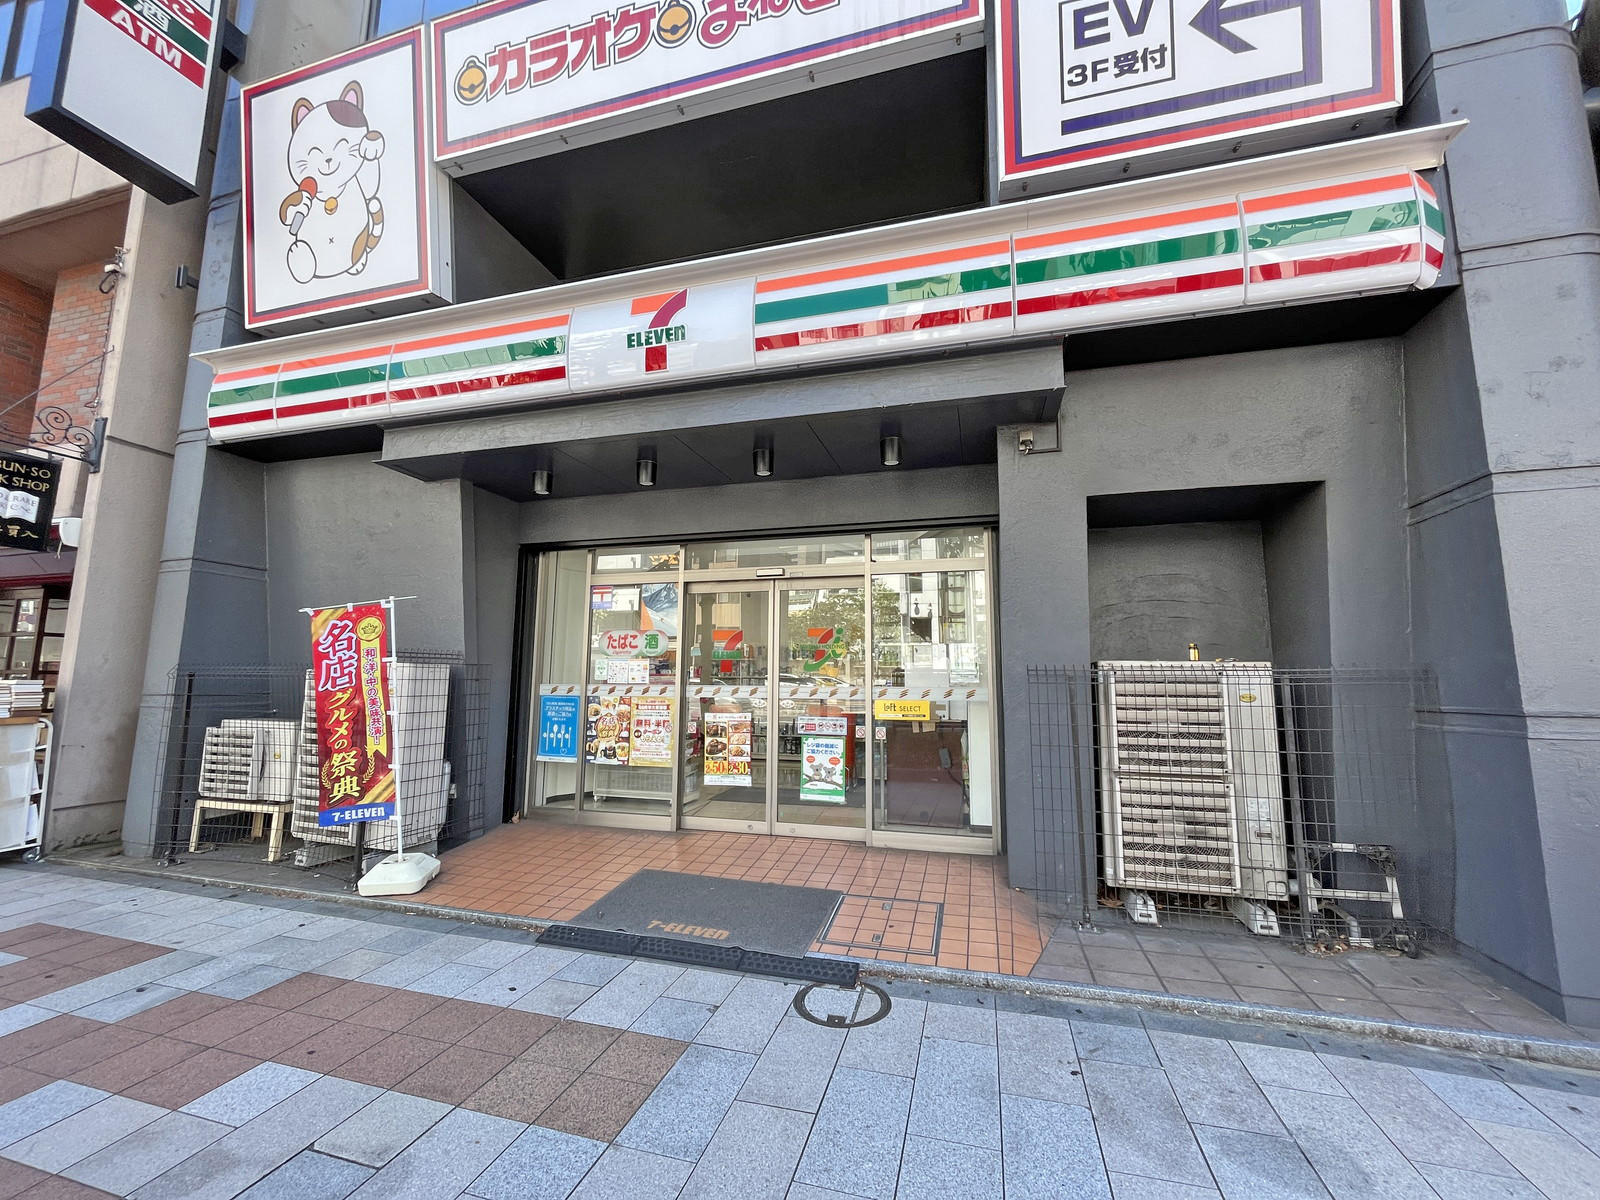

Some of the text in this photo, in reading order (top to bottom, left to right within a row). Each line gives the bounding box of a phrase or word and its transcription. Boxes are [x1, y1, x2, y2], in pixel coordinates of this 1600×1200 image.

[111, 9, 182, 69] ATM
[1073, 0, 1154, 50] EV
[487, 7, 657, 95] カラオケ
[0, 460, 51, 479] UN-SO
[12, 476, 50, 492] SHOP
[606, 633, 660, 650] たばこ 酒
